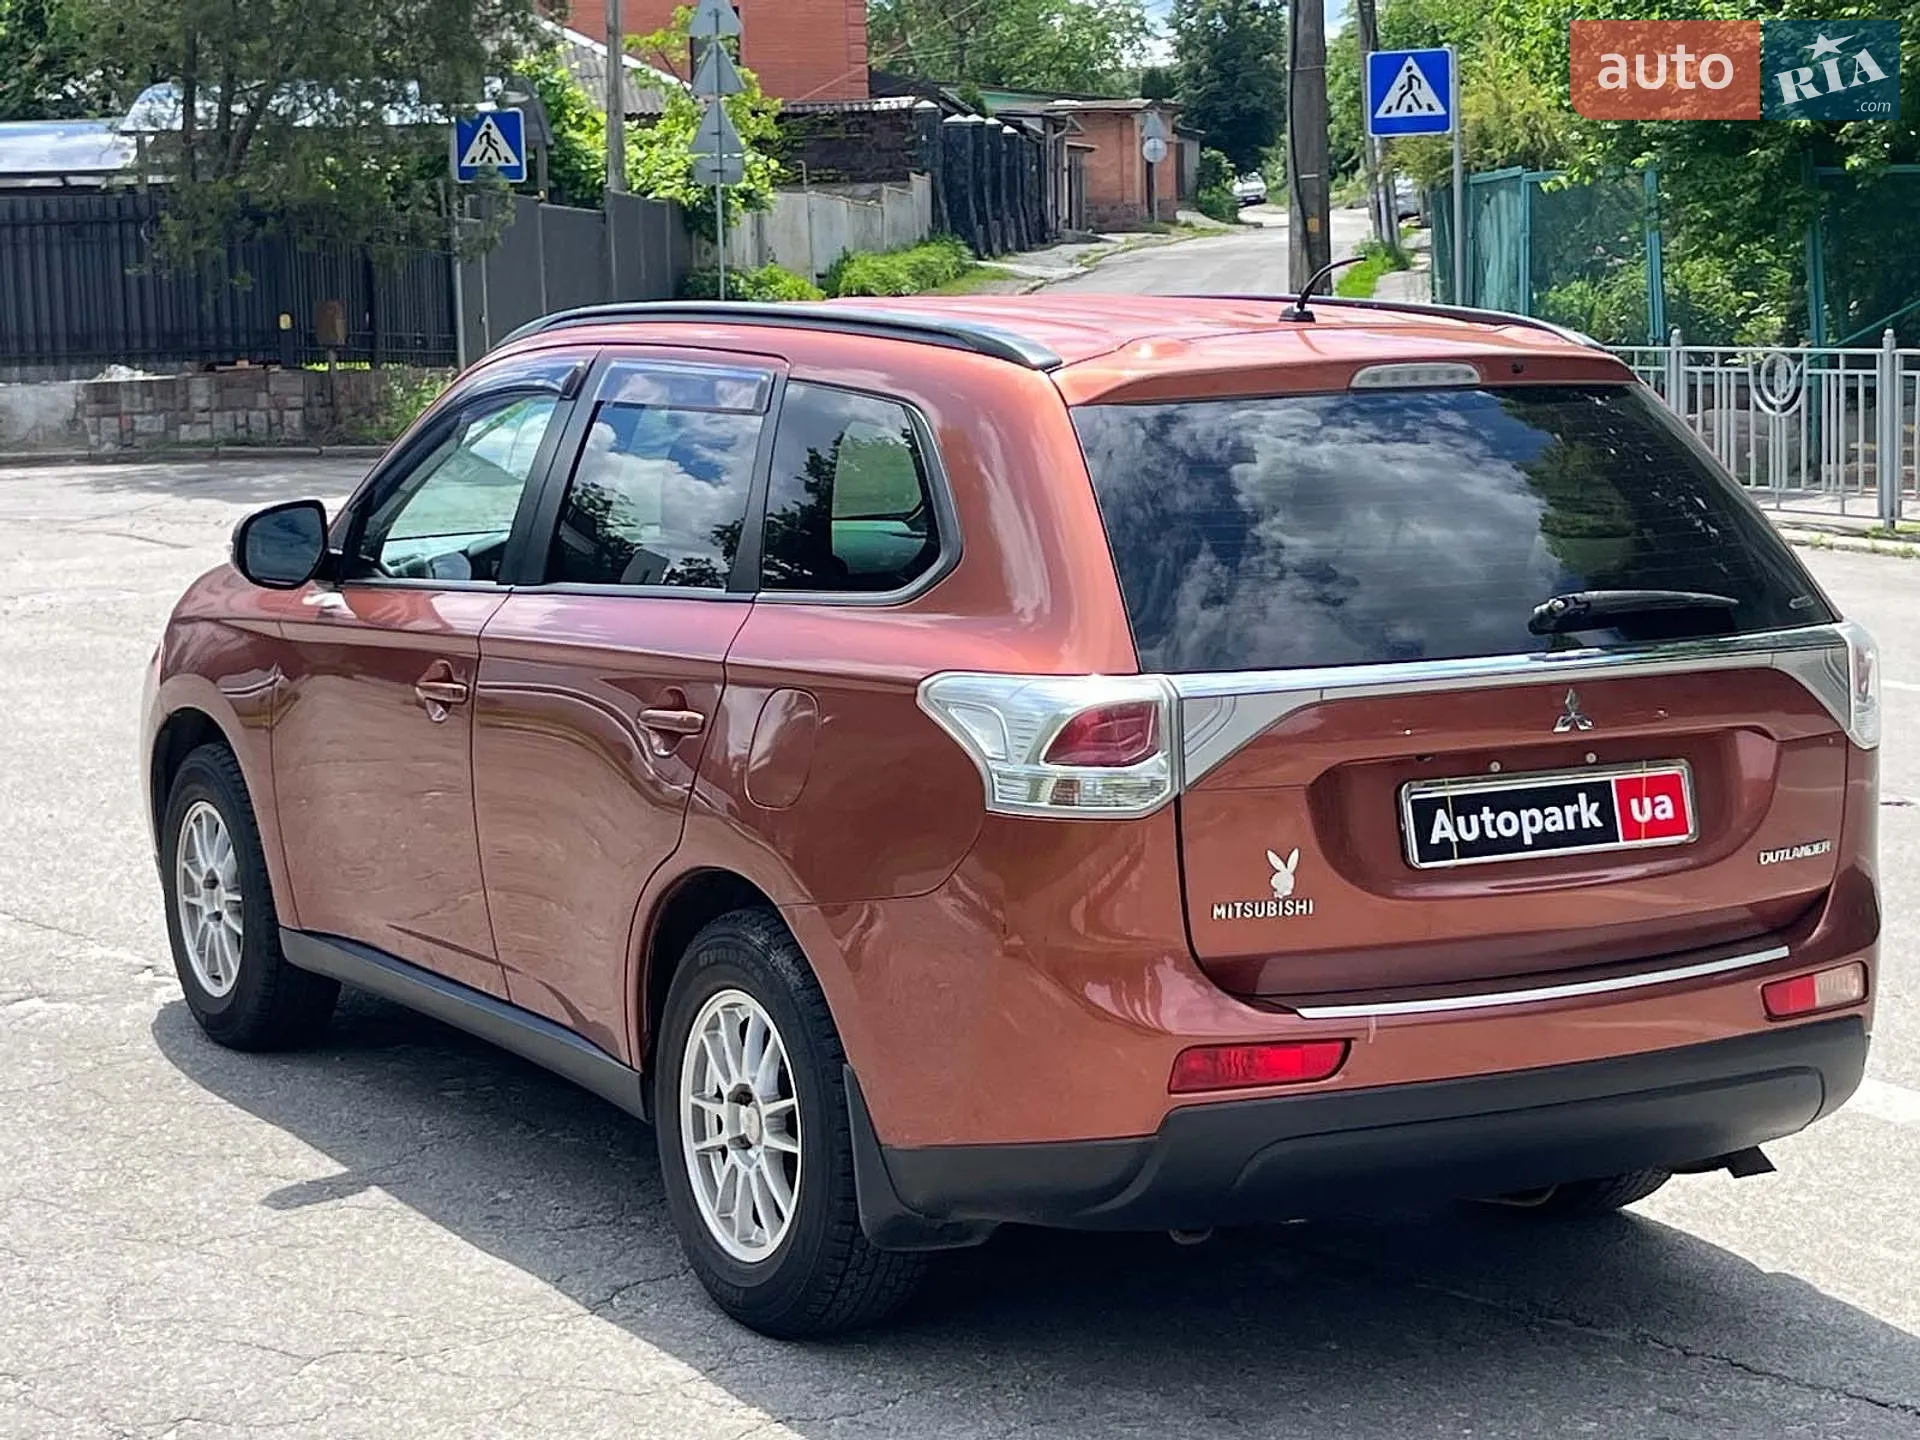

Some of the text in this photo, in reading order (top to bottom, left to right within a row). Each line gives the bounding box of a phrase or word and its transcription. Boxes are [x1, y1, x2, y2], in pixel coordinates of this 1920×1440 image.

[1430, 792, 1675, 845] Autopark ua
[1760, 841, 1831, 865] OUTLANDER
[1212, 899, 1313, 920] MITSUBISHI
